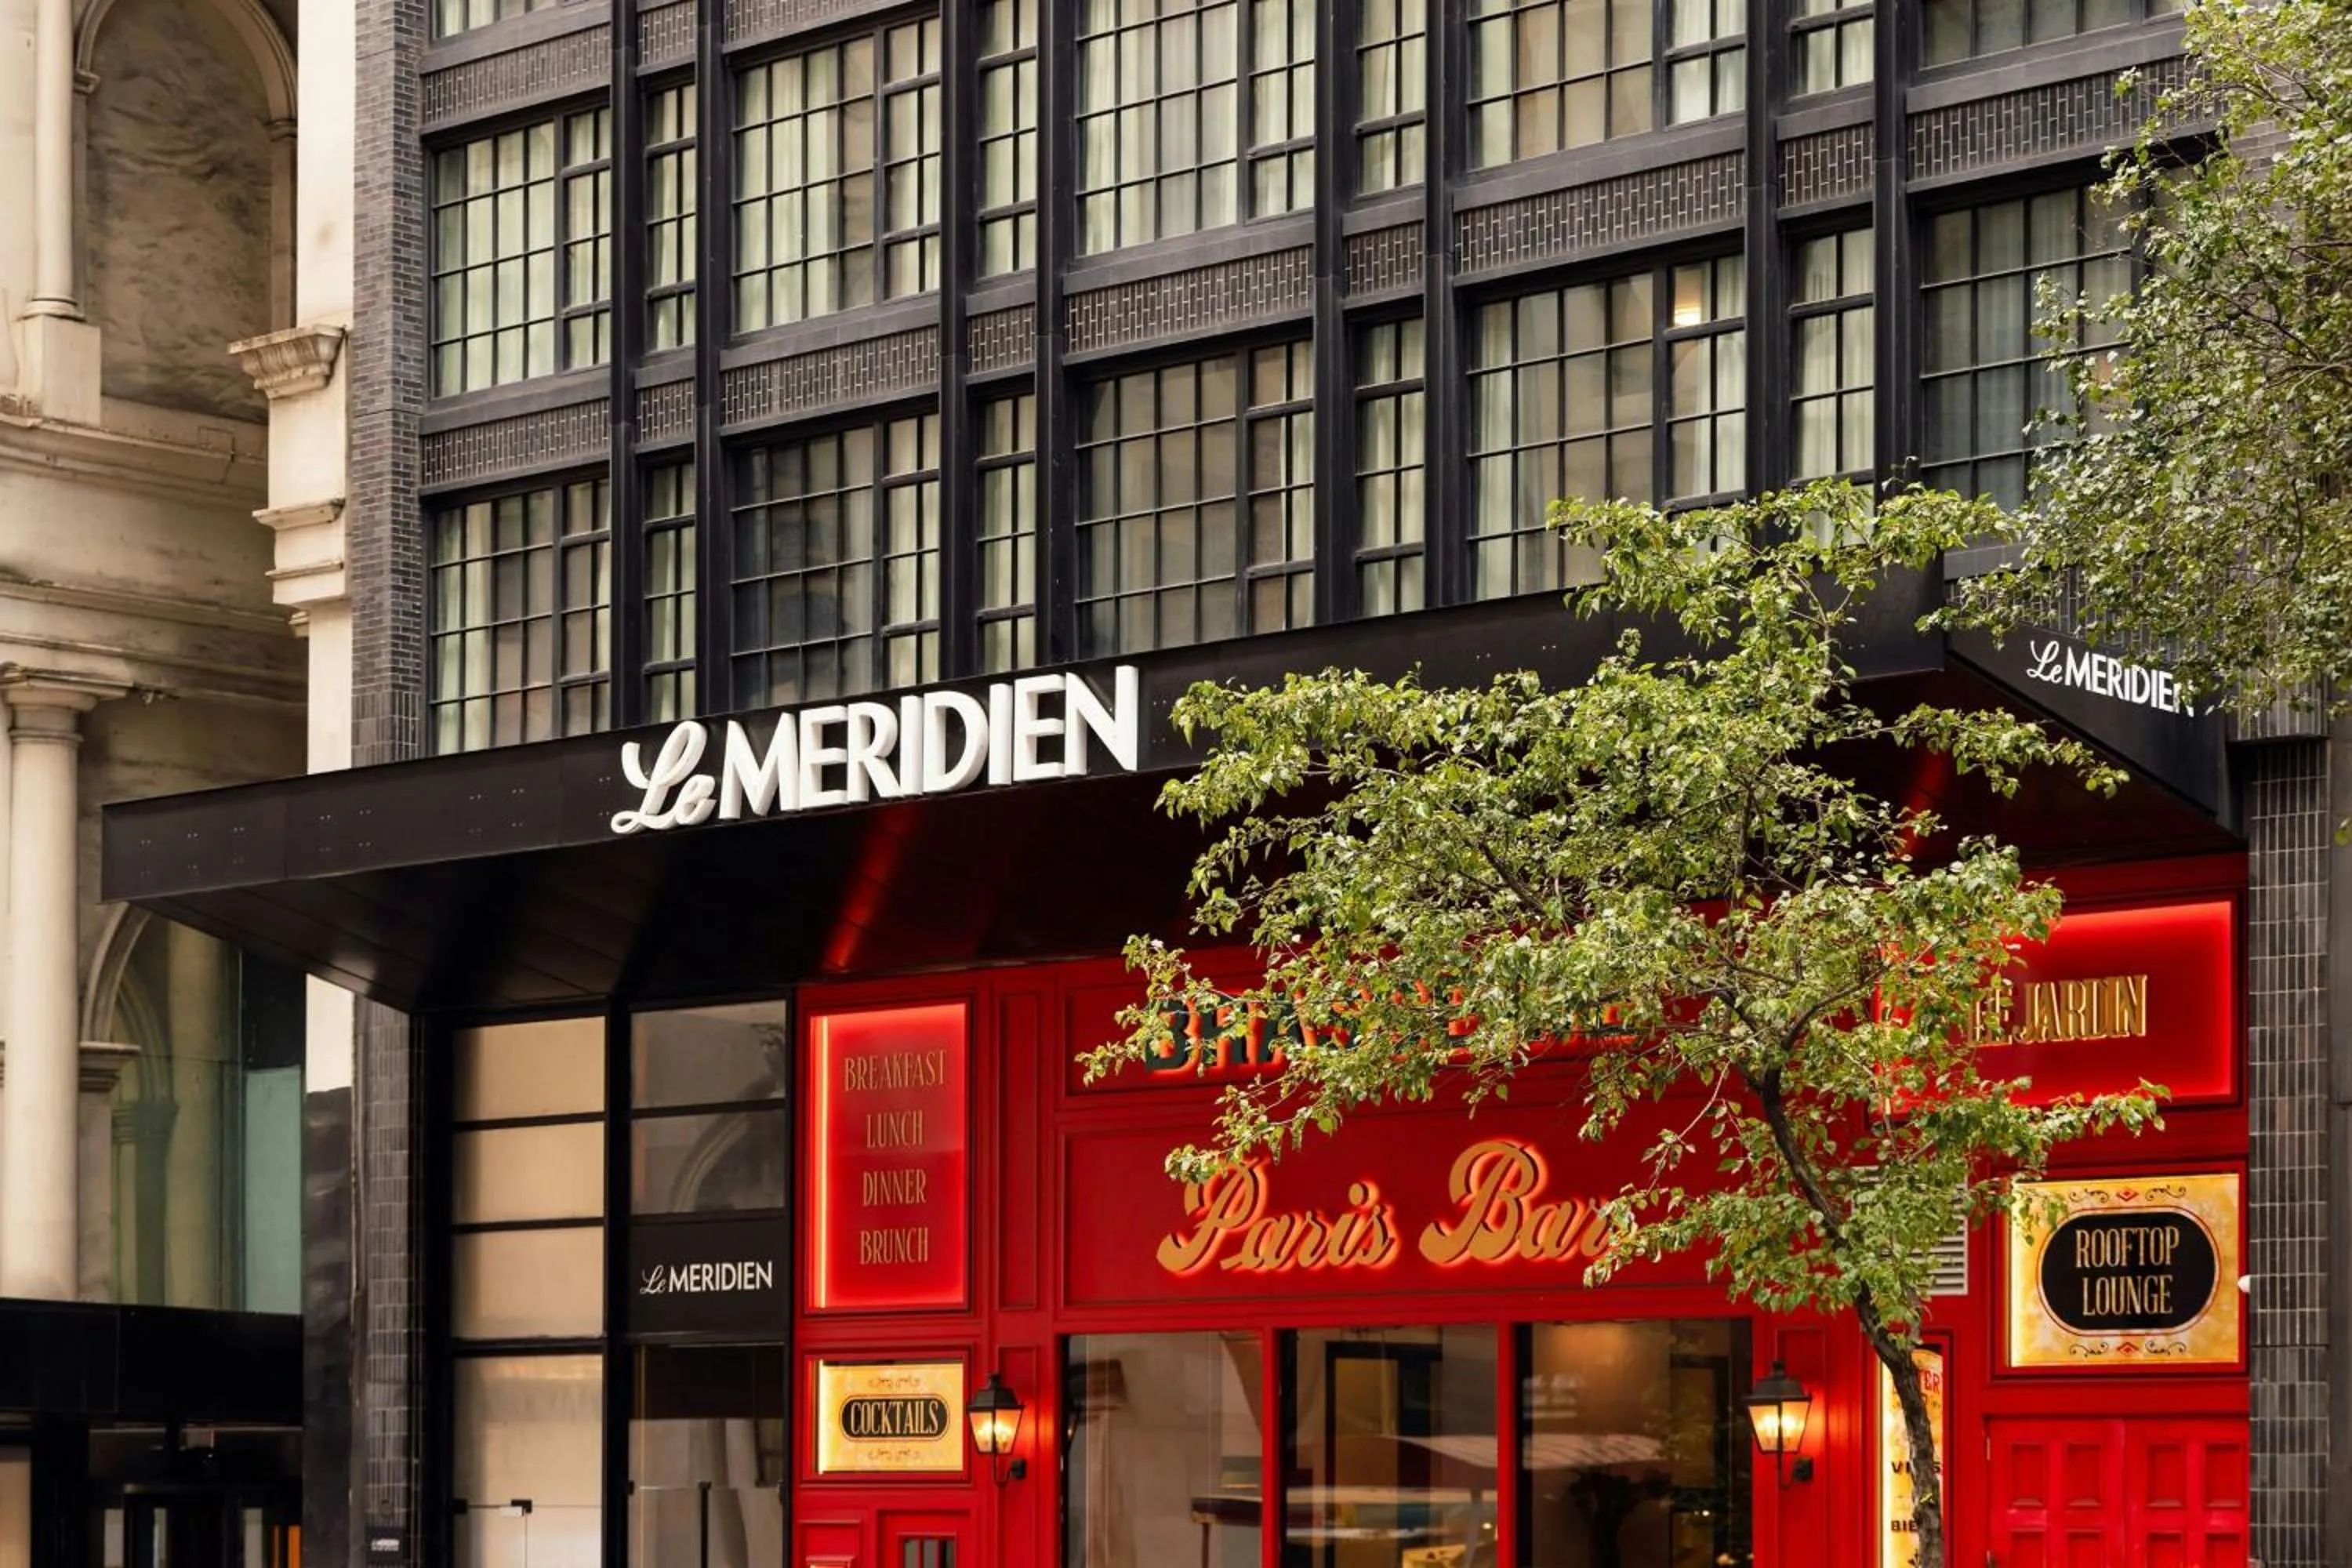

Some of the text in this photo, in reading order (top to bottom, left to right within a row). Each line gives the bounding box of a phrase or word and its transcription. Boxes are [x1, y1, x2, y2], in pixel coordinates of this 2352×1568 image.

[2026, 641, 2063, 684] Le
[611, 666, 1139, 834] Le MERIDIEN
[2012, 975, 2148, 1044] JARDIN
[844, 1050, 946, 1092] BREAKFAST
[866, 1109, 924, 1149] LUNCH
[863, 1169, 927, 1207] DINNER
[1156, 1141, 1612, 1273] Paris Bar
[860, 1227, 929, 1265] BRUNCH
[2075, 1226, 2180, 1269] ROOFTOP
[640, 1261, 773, 1295] Le MERIDIEN
[2082, 1275, 2173, 1317] LOUNGE
[851, 1400, 939, 1436] COCKTAILS
